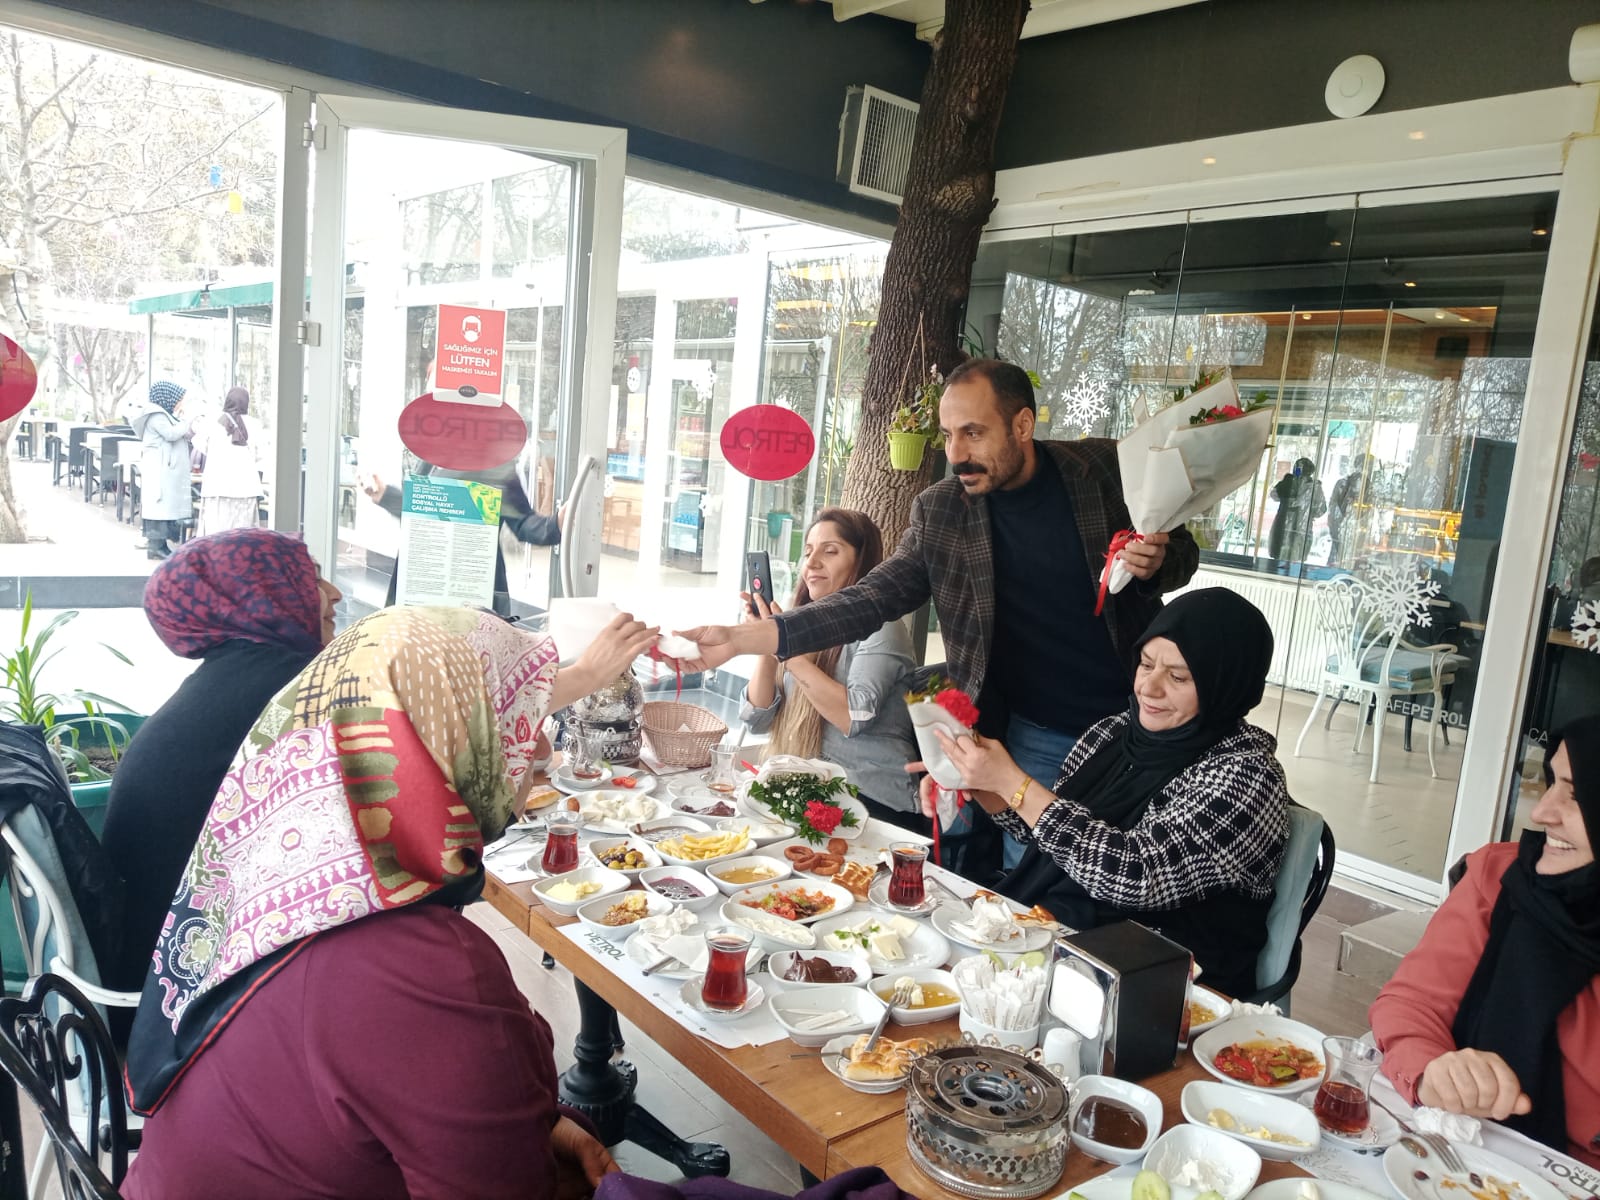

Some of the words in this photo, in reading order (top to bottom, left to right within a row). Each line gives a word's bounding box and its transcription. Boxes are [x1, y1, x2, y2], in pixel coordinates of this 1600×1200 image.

[450, 353, 490, 368] LÜTFEN
[411, 499, 435, 507] SOSYAL
[412, 493, 448, 502] KONTROLLÜ
[411, 505, 438, 513] ÇALIŞMA
[583, 932, 626, 961] PETROL
[1540, 1154, 1600, 1198] TROL
